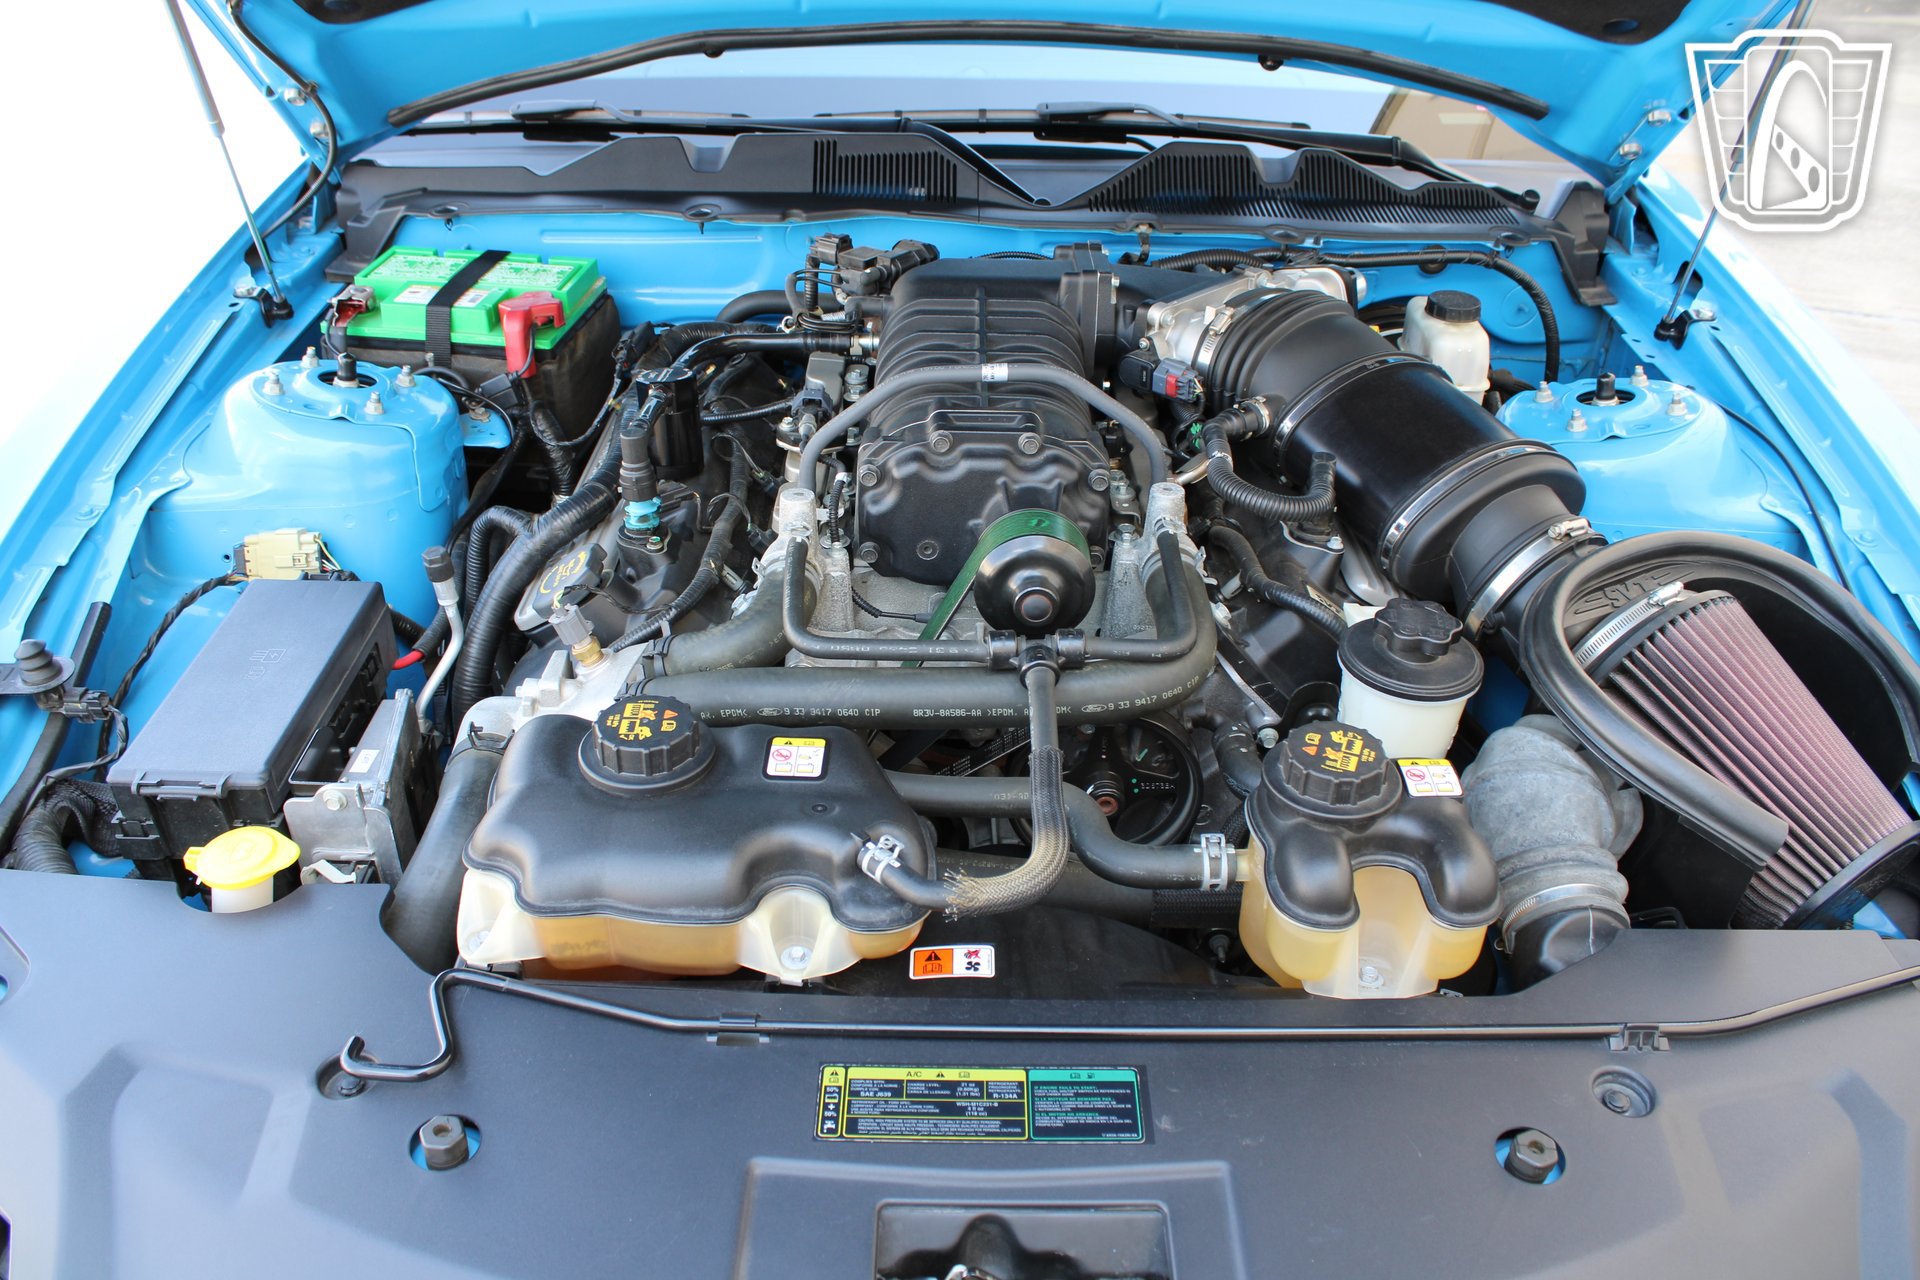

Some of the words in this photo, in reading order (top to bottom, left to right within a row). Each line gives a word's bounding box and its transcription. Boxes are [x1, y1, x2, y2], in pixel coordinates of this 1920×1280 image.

[1108, 702, 1115, 710] 9
[1118, 700, 1130, 709] 33
[1135, 695, 1157, 706] 9417
[1162, 686, 1183, 699] 0640
[783, 707, 790, 715] 9
[793, 707, 805, 716] 33
[837, 708, 859, 717] 0640
